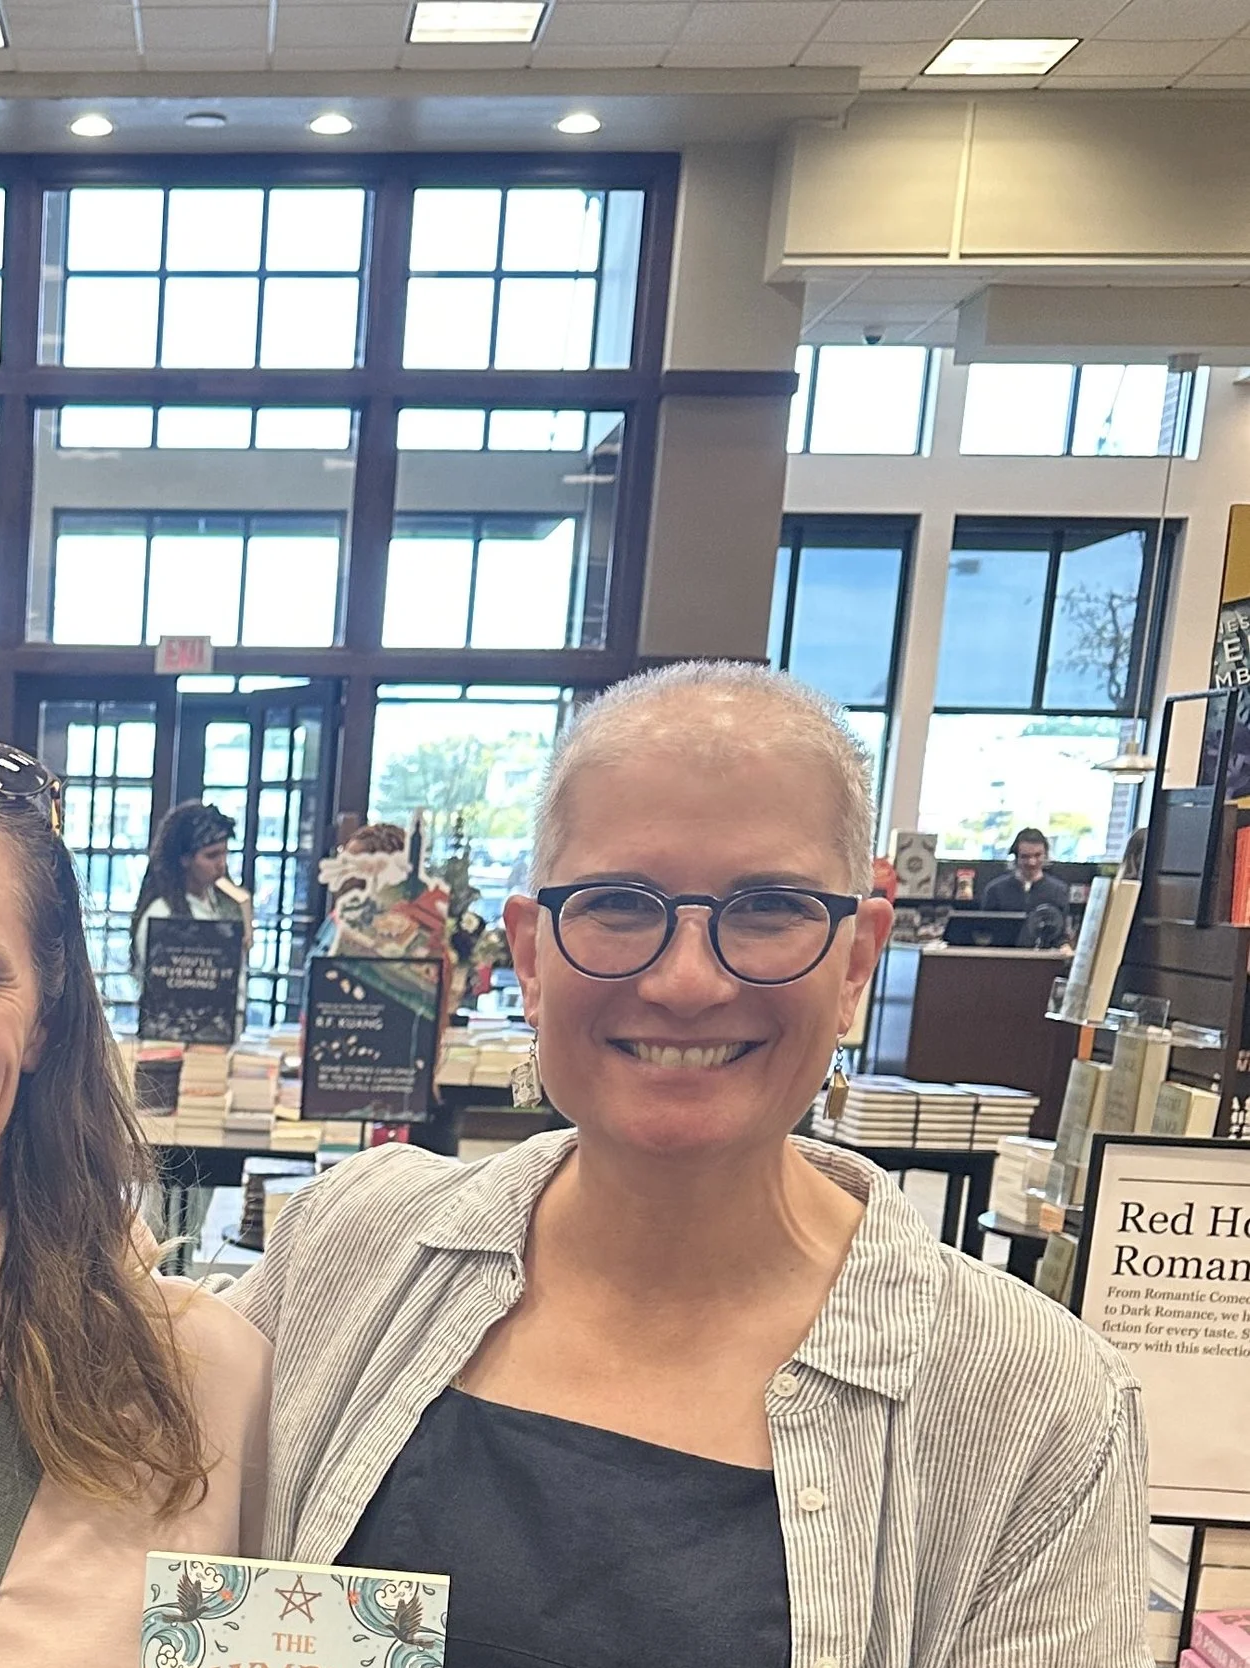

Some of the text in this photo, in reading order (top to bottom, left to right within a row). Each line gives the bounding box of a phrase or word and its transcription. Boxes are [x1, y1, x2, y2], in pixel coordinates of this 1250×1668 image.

[166, 978, 217, 990] COMING
[337, 1017, 384, 1031] KUANG
[1117, 1202, 1194, 1236] Red
[1111, 1245, 1250, 1282] Roman
[1107, 1286, 1141, 1299] From
[1145, 1288, 1206, 1302] Romantic
[1104, 1305, 1117, 1316] to
[1120, 1305, 1150, 1317] Dark
[1154, 1306, 1217, 1322] Romance,
[1221, 1312, 1239, 1322] we
[1102, 1320, 1141, 1334] fiction
[1145, 1321, 1163, 1335] for
[1166, 1327, 1200, 1339] every
[1204, 1325, 1237, 1339] taste.
[1144, 1339, 1172, 1353] with
[1176, 1340, 1199, 1354] this
[272, 1632, 316, 1654] THE
